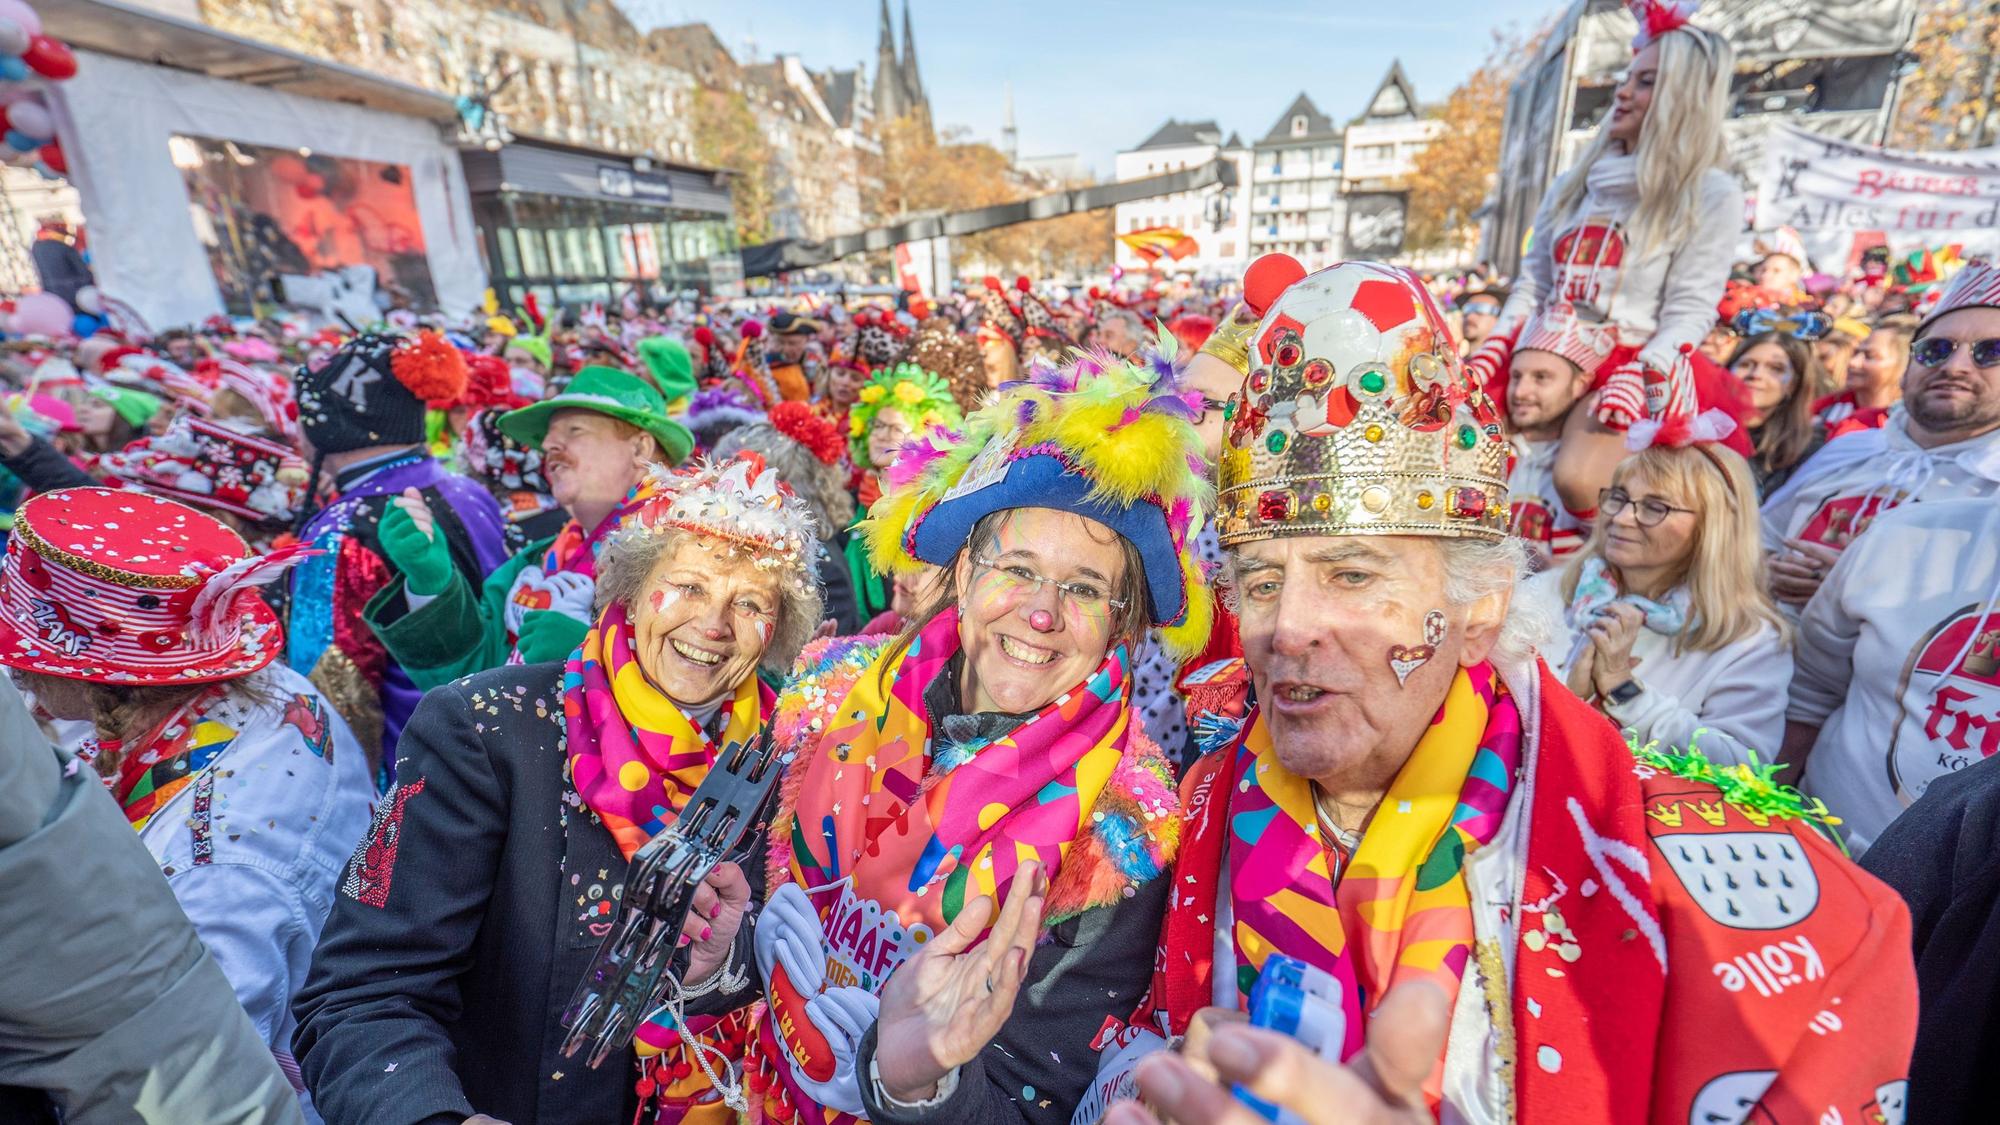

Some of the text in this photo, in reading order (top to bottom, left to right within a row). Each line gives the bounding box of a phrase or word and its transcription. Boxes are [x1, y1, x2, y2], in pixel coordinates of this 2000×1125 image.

[330, 355, 382, 405] K
[30, 597, 93, 656] ALAAF
[1183, 772, 1216, 821] Kölle
[1712, 935, 1825, 998] Kölle
